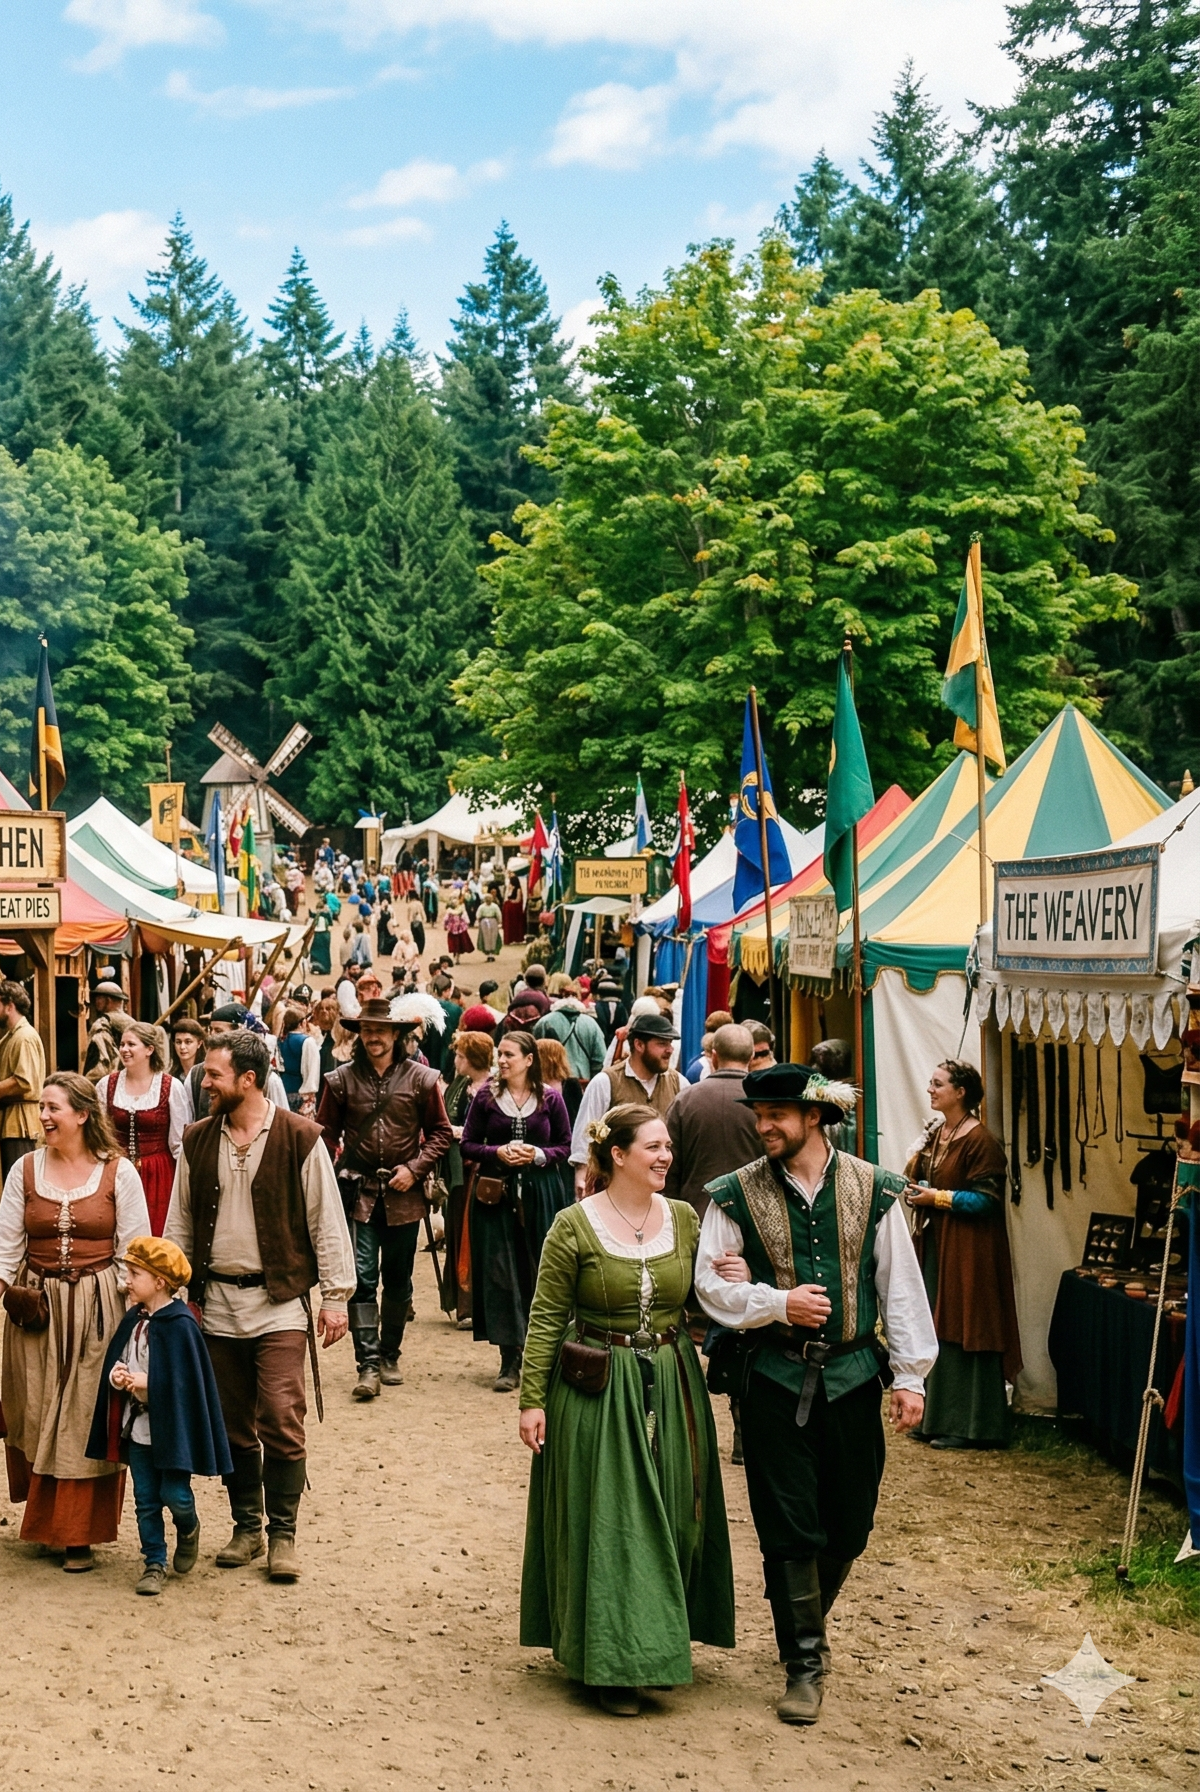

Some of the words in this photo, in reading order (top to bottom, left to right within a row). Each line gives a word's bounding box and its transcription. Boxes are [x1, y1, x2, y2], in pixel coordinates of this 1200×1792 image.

[25, 897, 50, 919] PIES
[1004, 892, 1039, 941] THE
[1044, 882, 1144, 942] WEAVERY
